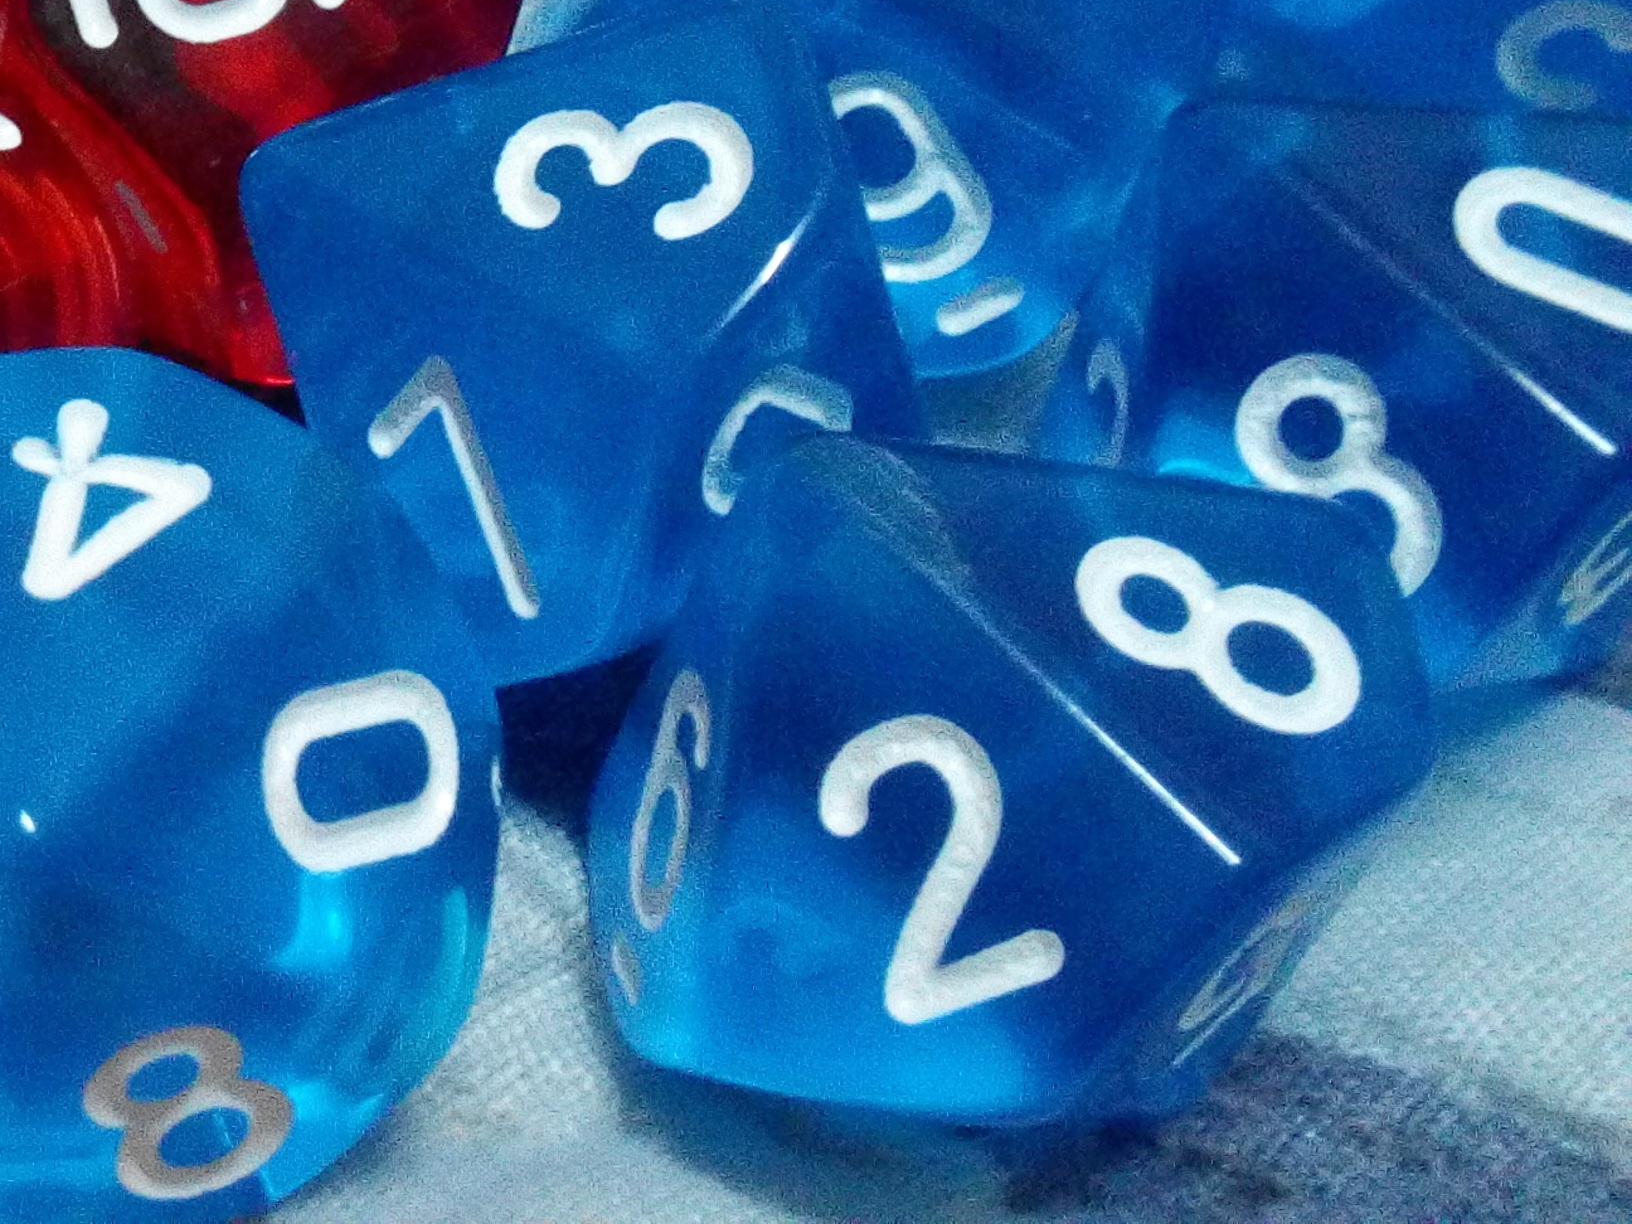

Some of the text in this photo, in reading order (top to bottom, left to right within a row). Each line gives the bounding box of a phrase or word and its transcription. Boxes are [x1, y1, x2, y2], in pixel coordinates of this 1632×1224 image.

[492, 100, 756, 242] 3
[10, 398, 214, 602] 4
[1073, 534, 1364, 736] 8
[261, 669, 460, 874] 0
[818, 712, 1068, 1028] 2
[80, 1022, 296, 1200] 8
